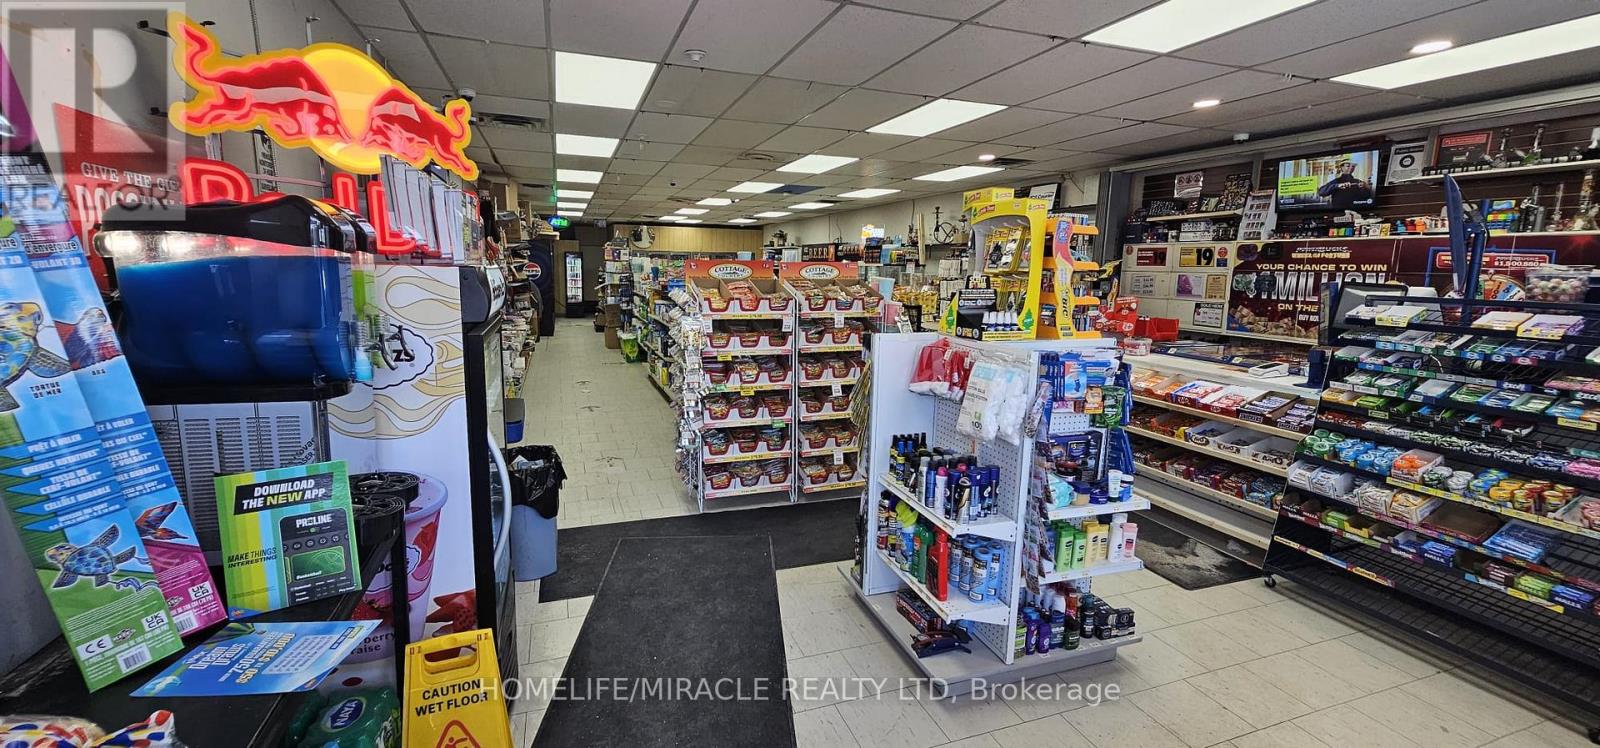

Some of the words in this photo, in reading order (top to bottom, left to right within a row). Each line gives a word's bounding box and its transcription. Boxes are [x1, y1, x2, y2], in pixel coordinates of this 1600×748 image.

[81, 162, 120, 183] GIVE
[123, 171, 151, 188] THE
[1195, 248, 1214, 266] 19
[714, 264, 749, 275] COTTAGE
[805, 264, 835, 275] COTTAGE
[1256, 263, 1285, 271] YOUR
[1287, 263, 1336, 271] CHANCE
[1339, 263, 1357, 271] TO
[1296, 304, 1319, 312] THE
[254, 479, 315, 497] DOWNLOAD
[242, 498, 264, 510] THE
[266, 491, 303, 506] NEW
[304, 488, 327, 500] APP
[228, 552, 250, 563] MAKE
[250, 547, 277, 559] THINGS
[228, 554, 277, 568] INTERESTING
[85, 639, 107, 654] CE
[422, 679, 480, 700] CAUTION
[415, 700, 445, 717] WET
[447, 691, 488, 710] FLOOR
[334, 699, 359, 727] NAYA
